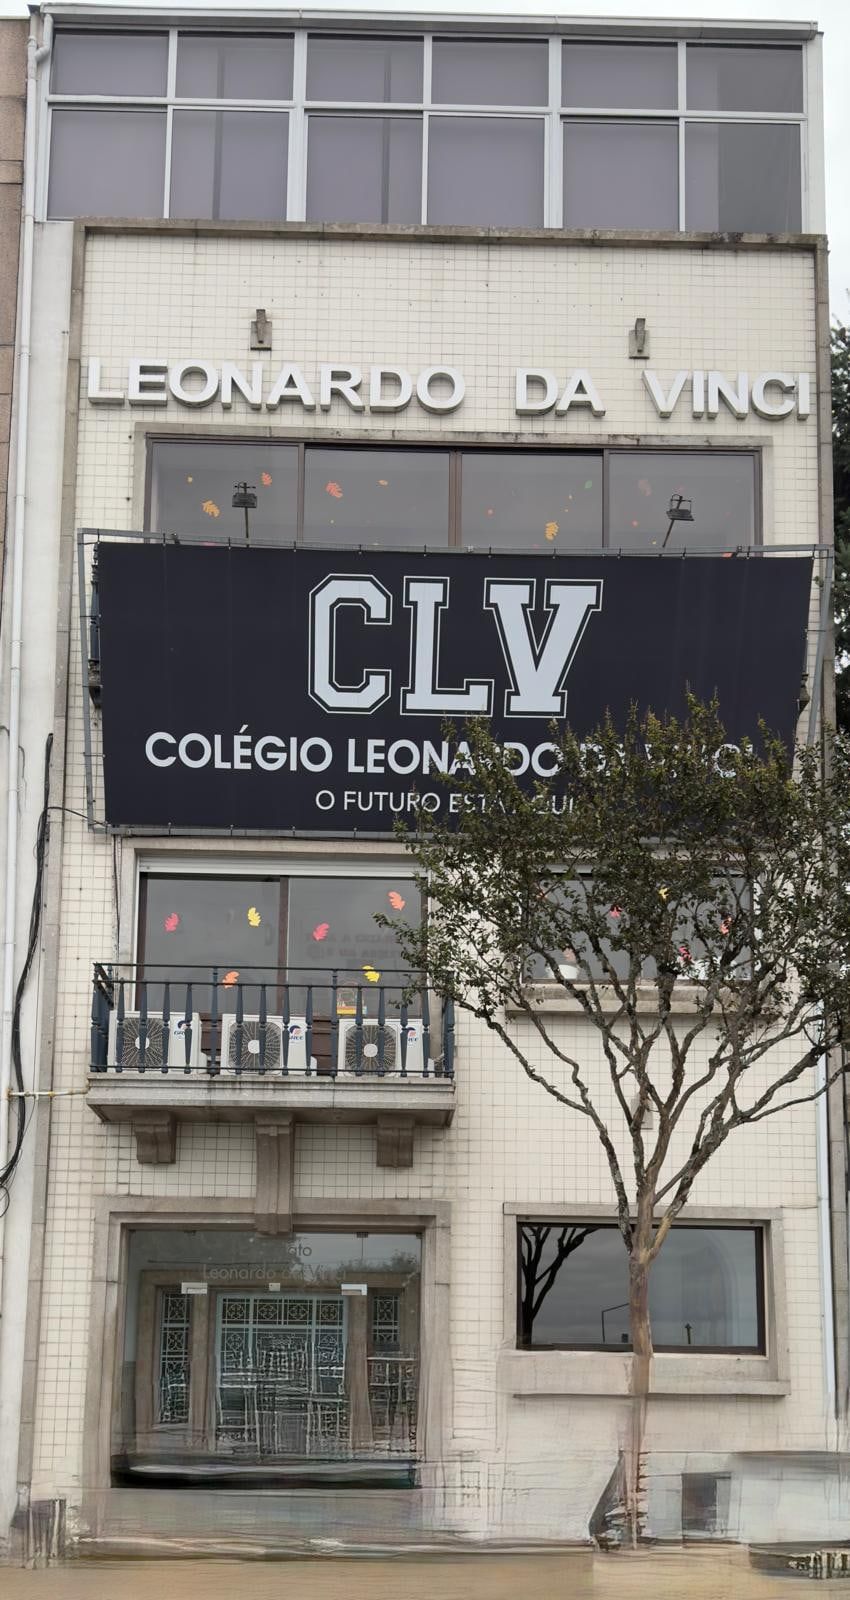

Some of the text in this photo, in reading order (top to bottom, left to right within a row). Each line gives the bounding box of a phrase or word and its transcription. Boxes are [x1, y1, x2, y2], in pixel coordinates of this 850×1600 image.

[87, 356, 810, 421] LEONARDO DA VINCI
[308, 573, 604, 719] CLV
[145, 724, 333, 772] COLÉGIO
[348, 738, 563, 778] LEONADO
[315, 789, 335, 811] O
[343, 791, 441, 813] FUTURO
[203, 1262, 276, 1281] Leonardo
